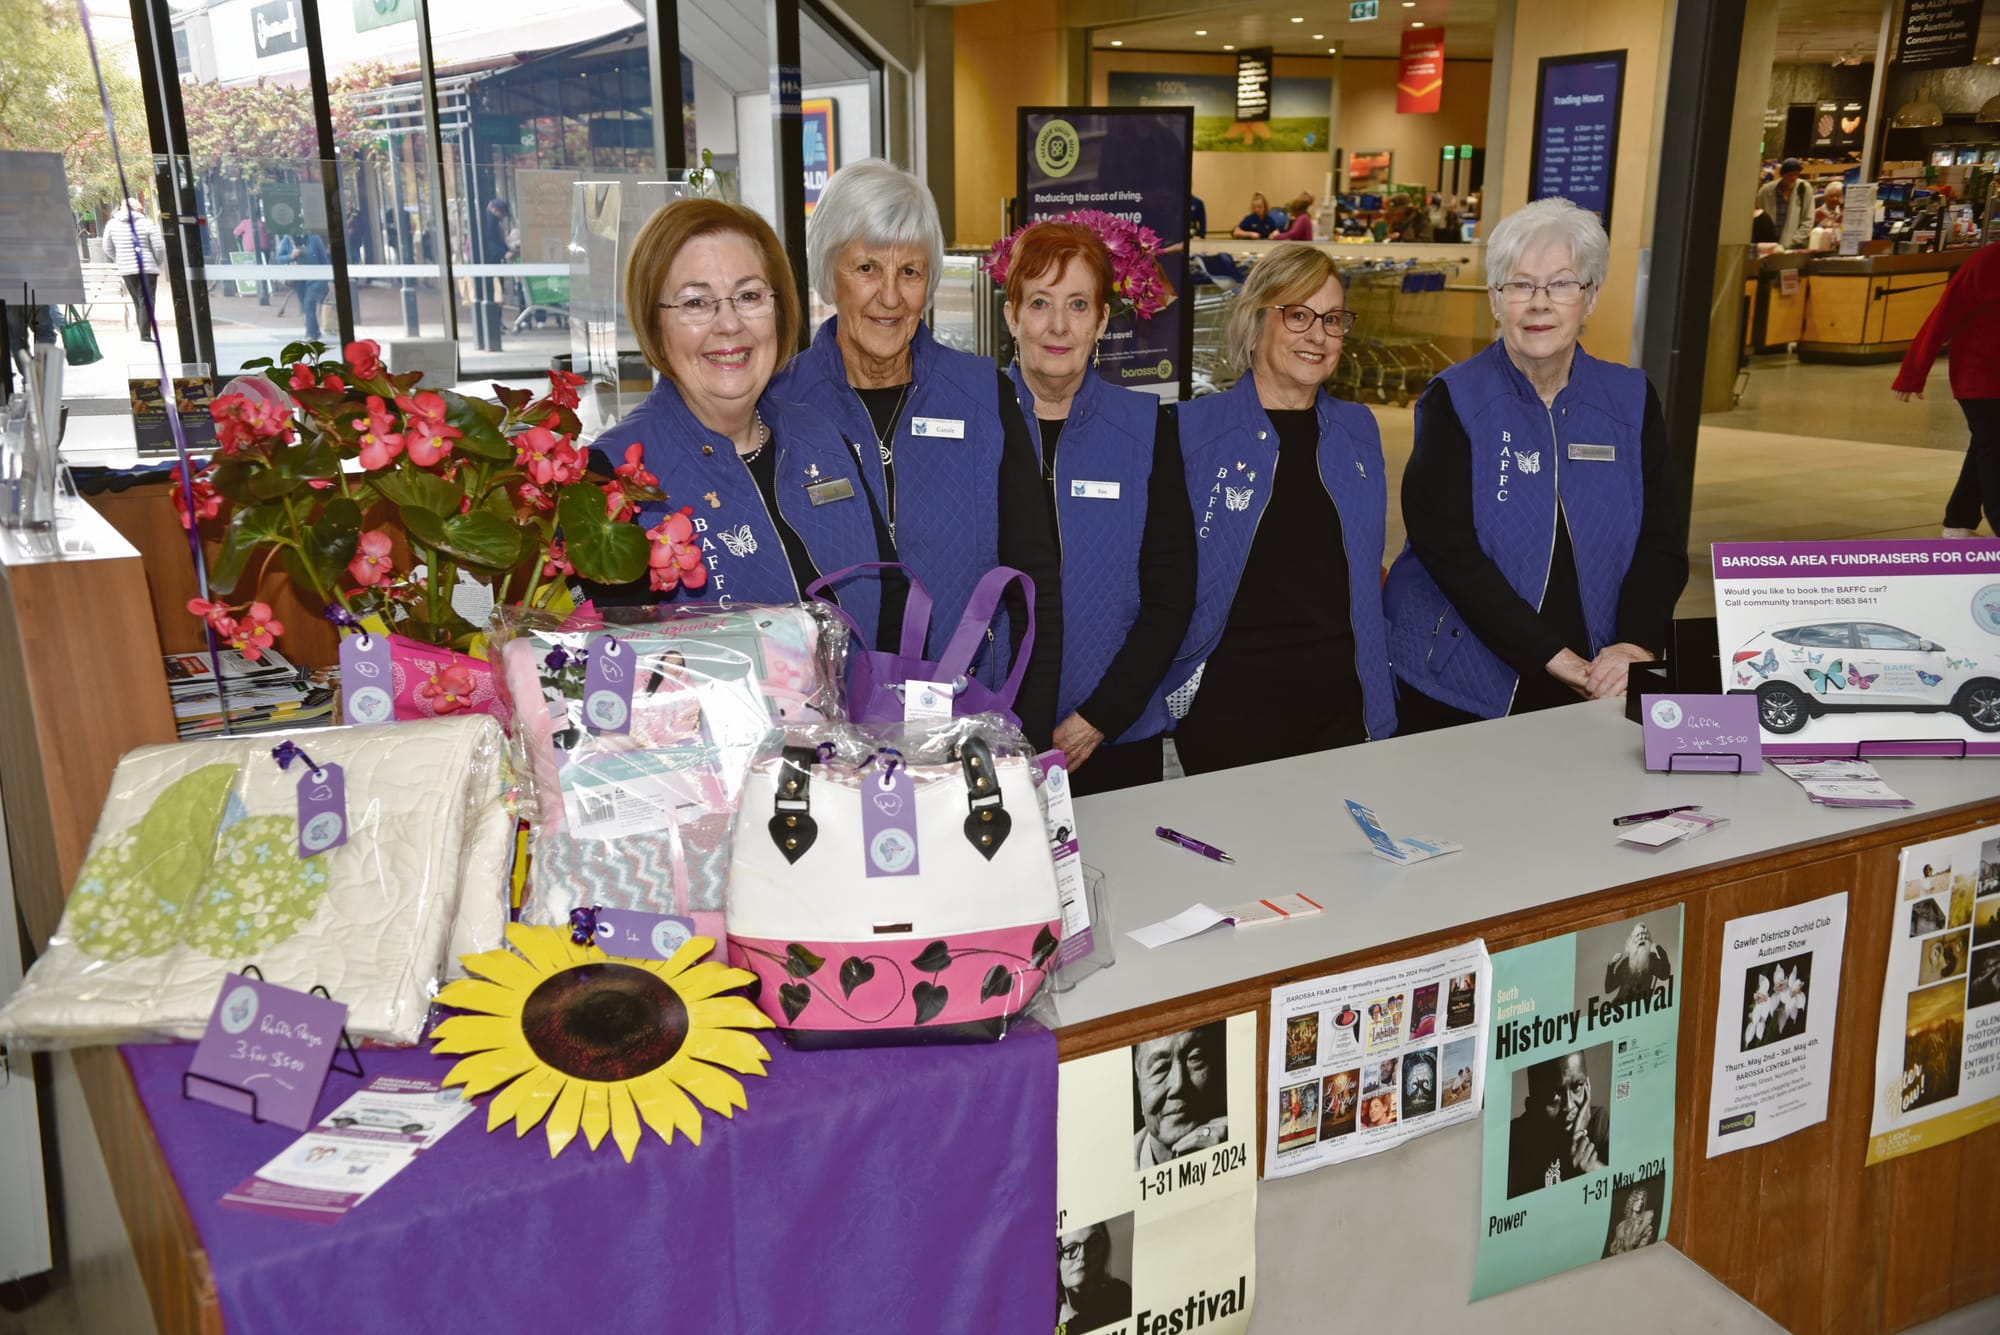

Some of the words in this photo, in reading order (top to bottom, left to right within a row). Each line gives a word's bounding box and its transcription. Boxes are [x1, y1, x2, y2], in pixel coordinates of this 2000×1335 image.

[1905, 34, 1948, 46] Consumer
[1553, 94, 1582, 107] Trading
[1582, 94, 1604, 104] Hours
[1035, 192, 1074, 204] Reducing
[1075, 192, 1089, 201] the
[1090, 192, 1107, 201] cost
[1109, 191, 1118, 200] of
[1118, 190, 1143, 202] living.
[1113, 331, 1133, 341] save!
[1121, 367, 1158, 378] barossa
[1497, 431, 1511, 501] BAFFC
[1200, 467, 1228, 538] BAFFC
[695, 518, 731, 610] BAFFC
[1721, 555, 1787, 568] BAROSSA
[1790, 554, 1828, 566] AREA
[1831, 552, 1929, 565] FUNDRAISERS
[1933, 551, 1962, 564] FOR
[1724, 588, 1750, 596] Would
[1752, 589, 1768, 597] you
[1770, 587, 1784, 595] like
[1797, 587, 1818, 595] book
[1820, 586, 1834, 594] the
[1836, 586, 1867, 594] BAFFC
[1725, 599, 1741, 607] Call
[1743, 598, 1790, 608] community
[1792, 598, 1834, 606] transport:
[1836, 597, 1856, 605] 8563
[1858, 597, 1878, 605] 8411
[1676, 737, 1688, 749] 3
[1734, 937, 1760, 950] Gawler
[1761, 928, 1791, 944] Districts
[1792, 921, 1814, 936] Orchid
[1816, 917, 1831, 929] Club
[1758, 944, 1786, 958] Autumn
[1787, 938, 1807, 951] Show
[1286, 991, 1315, 1003] BAROSSA
[1316, 988, 1330, 998] FILM
[1331, 984, 1348, 994] CLUB
[1374, 975, 1397, 985] presents
[1405, 969, 1418, 978] 2024
[1418, 962, 1446, 974] Programme
[1497, 985, 1519, 1004] South
[1496, 1010, 1581, 1060] History
[1587, 974, 1675, 1032] Festival
[1497, 997, 1537, 1021] Australia's
[229, 1040, 245, 1060] 3
[1725, 1062, 1745, 1073] Thurs.
[1748, 1056, 1761, 1067] May
[1763, 1052, 1776, 1063] 2nd
[1781, 1047, 1792, 1057] Sat.
[1794, 1043, 1807, 1052] May
[1808, 1039, 1818, 1047] 4th
[1736, 1068, 1764, 1081] BAROSSA
[1765, 1060, 1791, 1073] CENTRAL
[1792, 1054, 1807, 1063] MALL
[1965, 1054, 1995, 1070] ENTRIES
[1967, 1069, 1976, 1080] 29
[1977, 1065, 1996, 1078] JULY
[1140, 1168, 1173, 1201] 1-31
[1179, 1161, 1207, 1188] May
[1212, 1142, 1247, 1177] 2024
[1583, 1177, 1608, 1205] 1-31
[1613, 1171, 1635, 1191] May
[1639, 1157, 1666, 1181] 2024
[1489, 1210, 1527, 1238] Power
[1136, 1276, 1246, 1335] Festival
